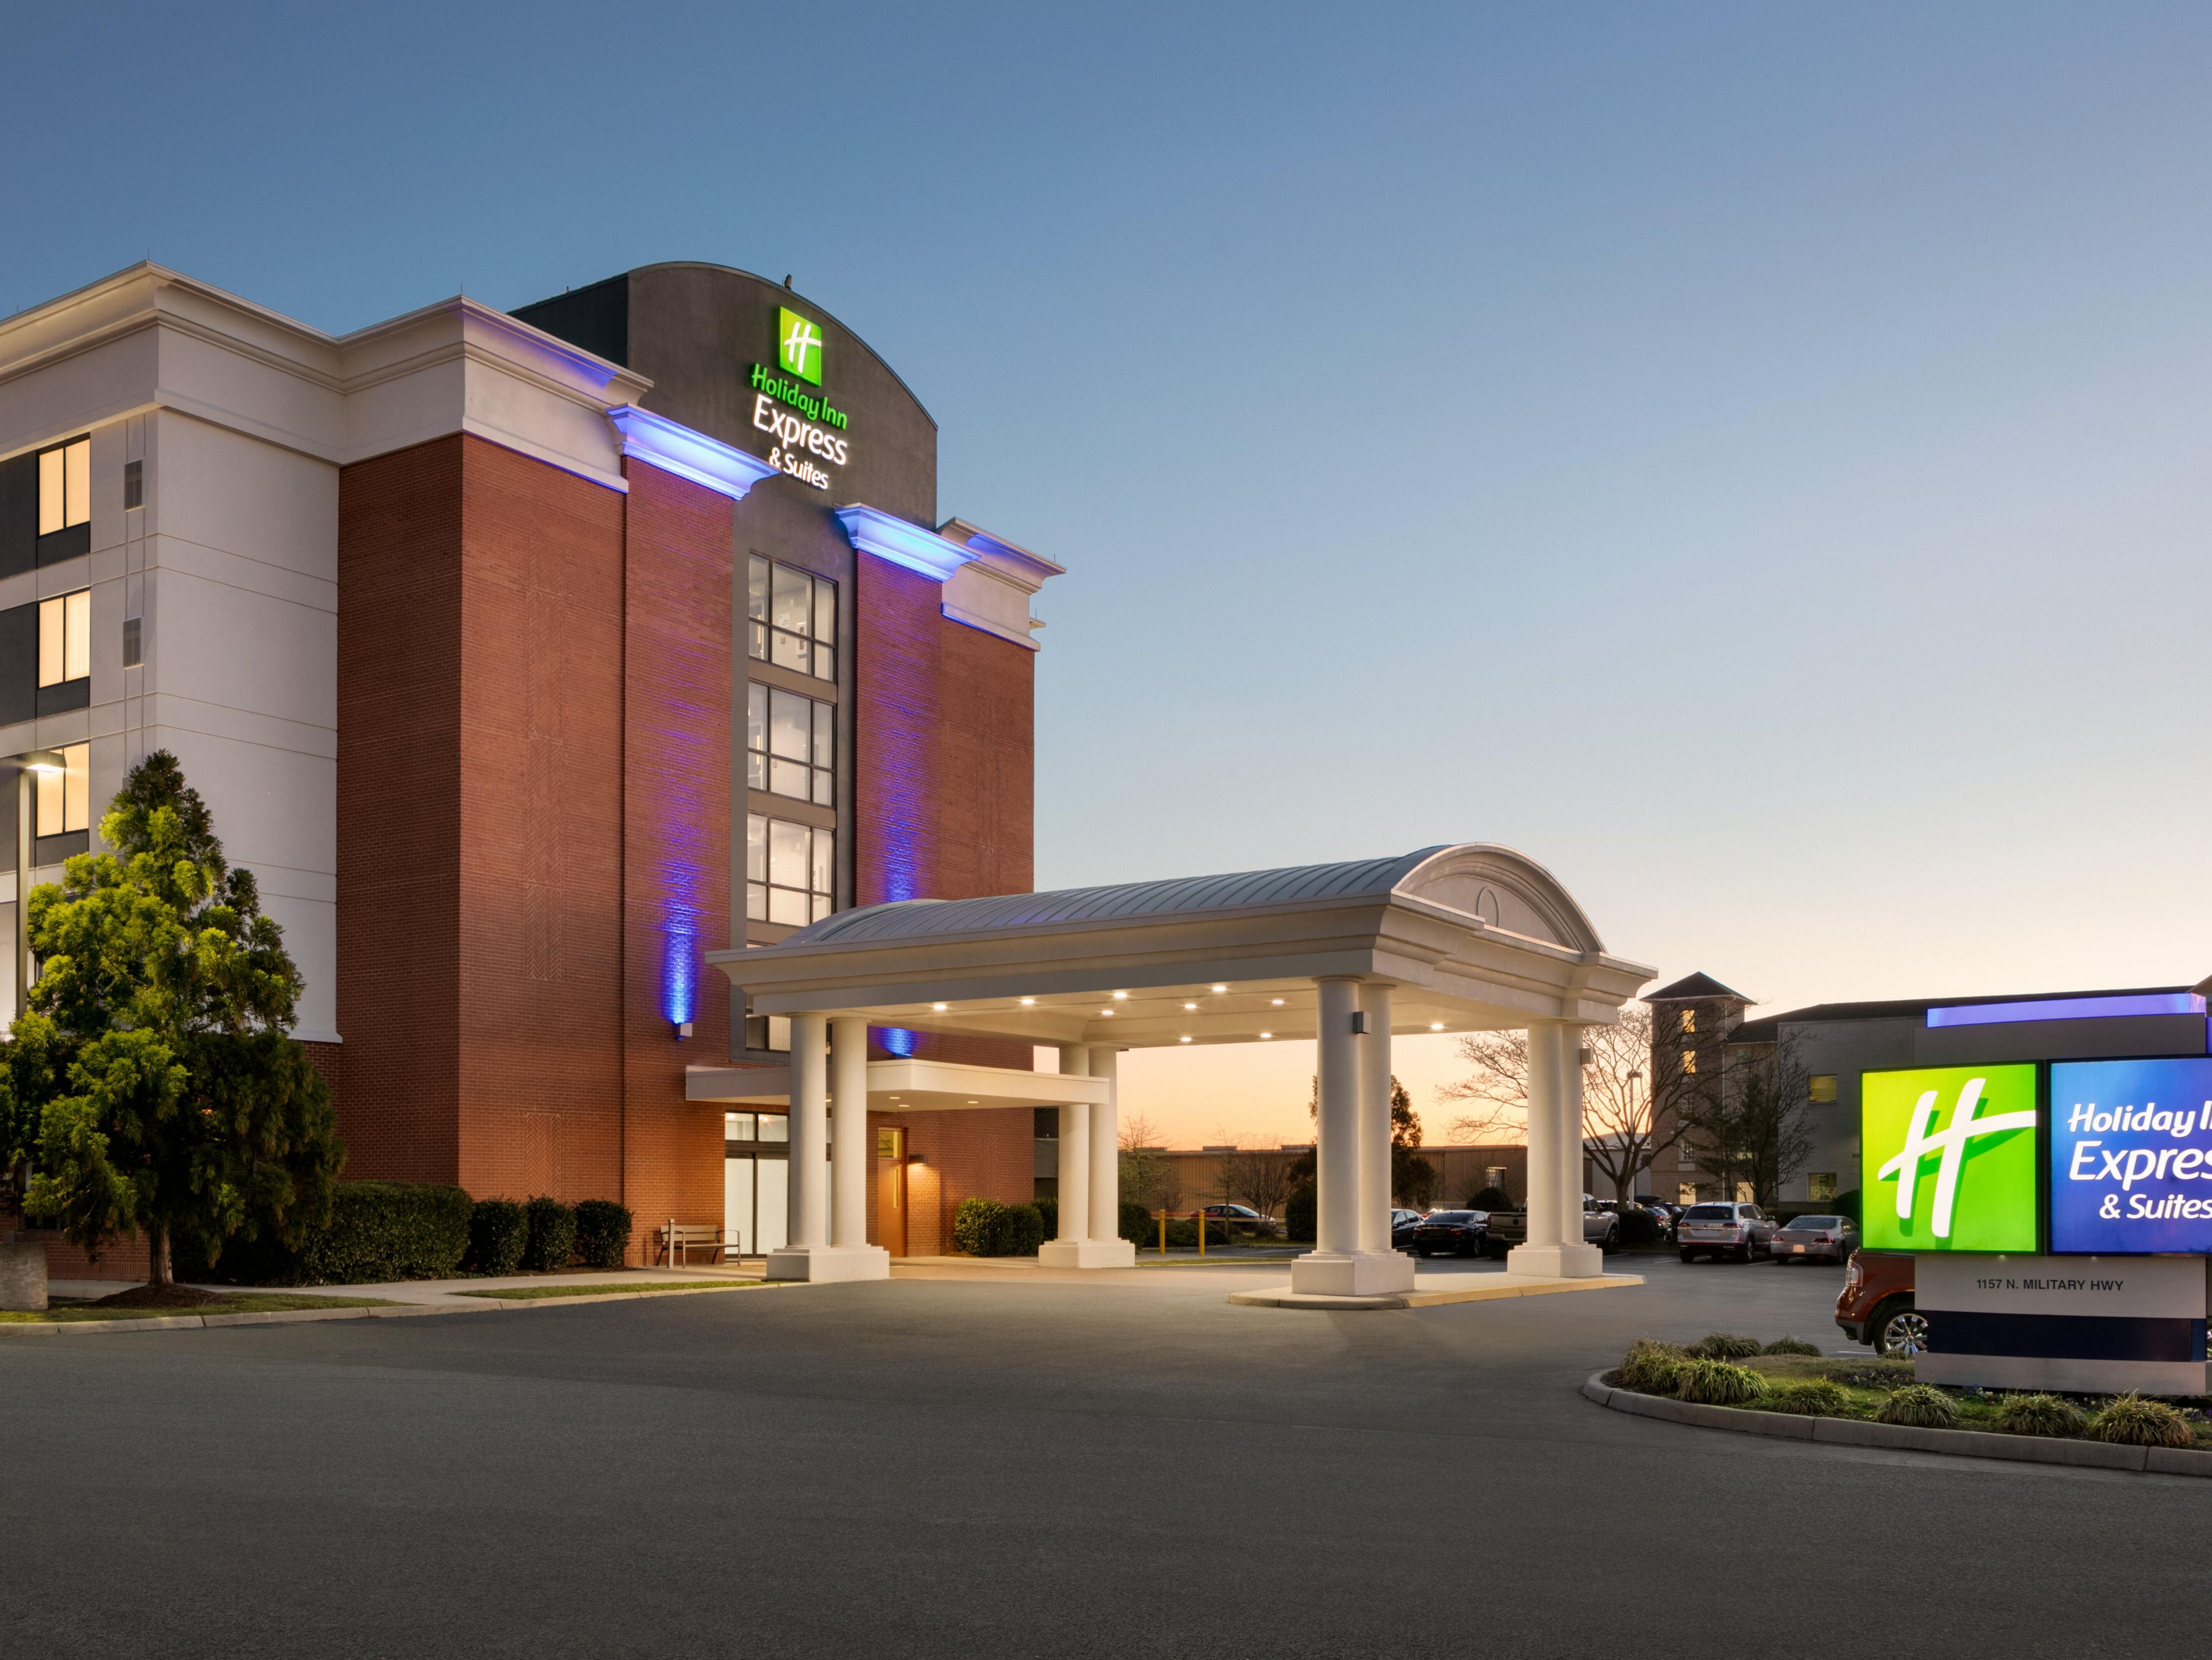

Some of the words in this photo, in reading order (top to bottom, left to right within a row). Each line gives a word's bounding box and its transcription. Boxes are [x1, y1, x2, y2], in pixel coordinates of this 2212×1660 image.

[752, 363, 820, 421] Holiday
[821, 396, 848, 430] Inn
[753, 393, 848, 466] Express
[769, 446, 781, 469] &
[782, 452, 829, 490] Suites
[2068, 1102, 2196, 1138] Holiday
[2099, 1194, 2121, 1219] &
[1976, 1279, 2002, 1289] 1157
[2006, 1279, 2019, 1289] N.
[2023, 1279, 2086, 1290] MILITARY
[2090, 1280, 2124, 1291] HWY
